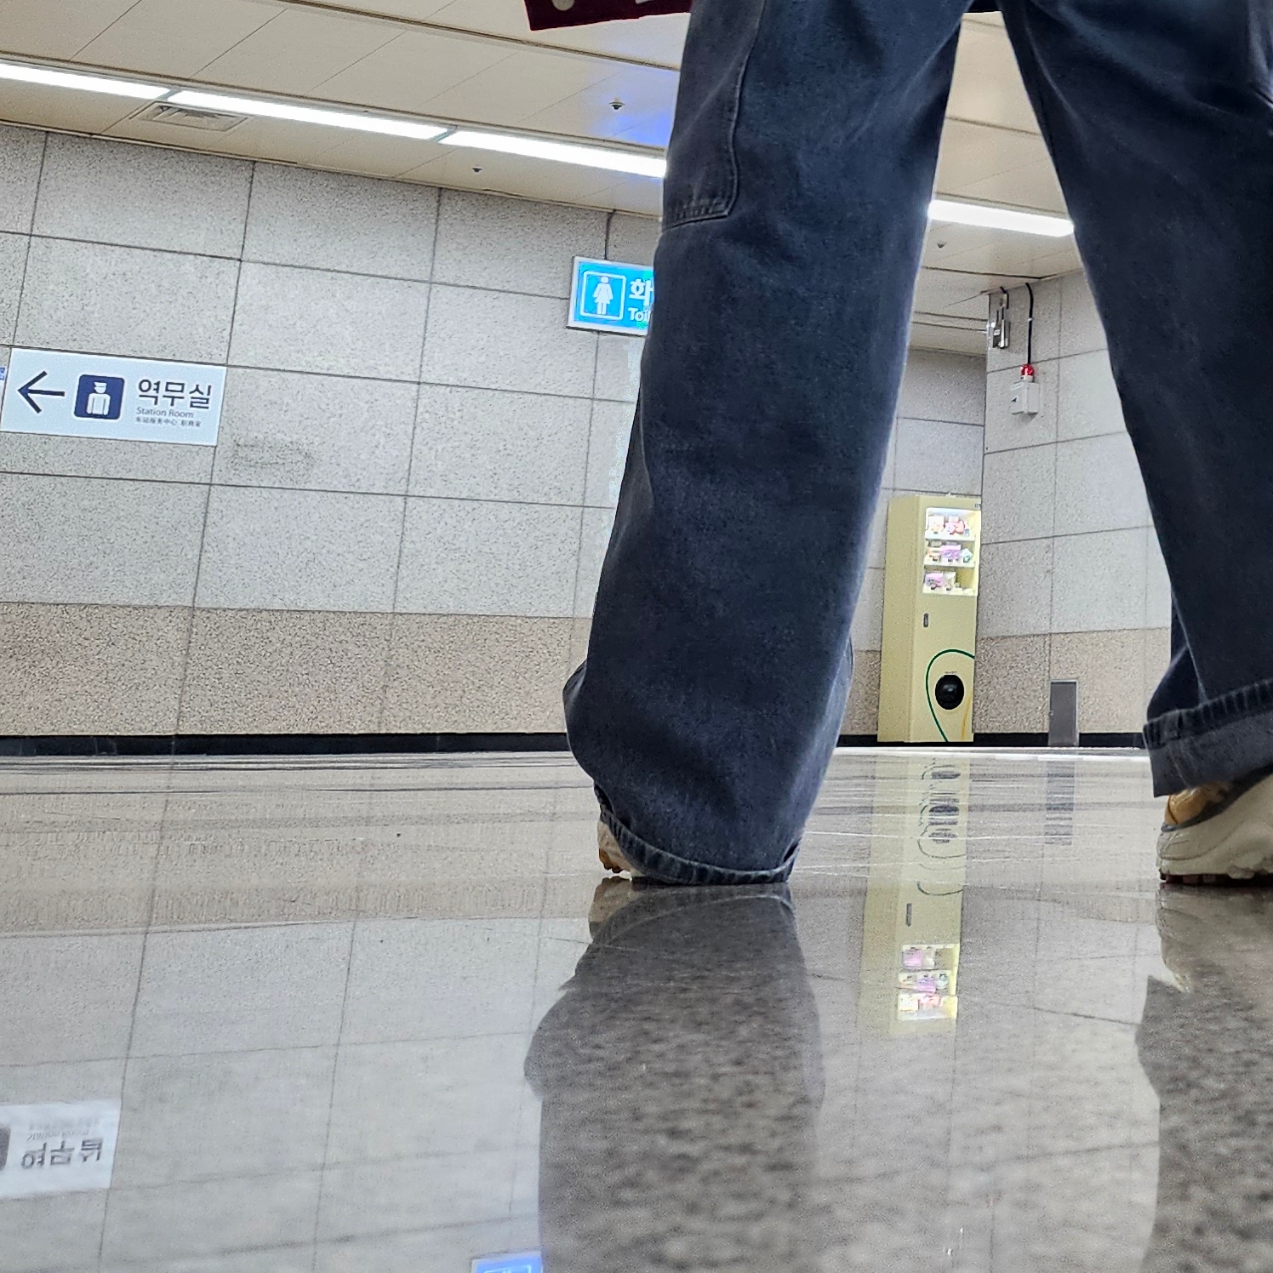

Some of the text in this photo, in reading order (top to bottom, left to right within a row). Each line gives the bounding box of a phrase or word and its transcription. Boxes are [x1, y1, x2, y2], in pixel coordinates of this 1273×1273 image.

[628, 278, 654, 307] 화
[138, 378, 212, 410] 역무실
[136, 406, 194, 419] Station Room
